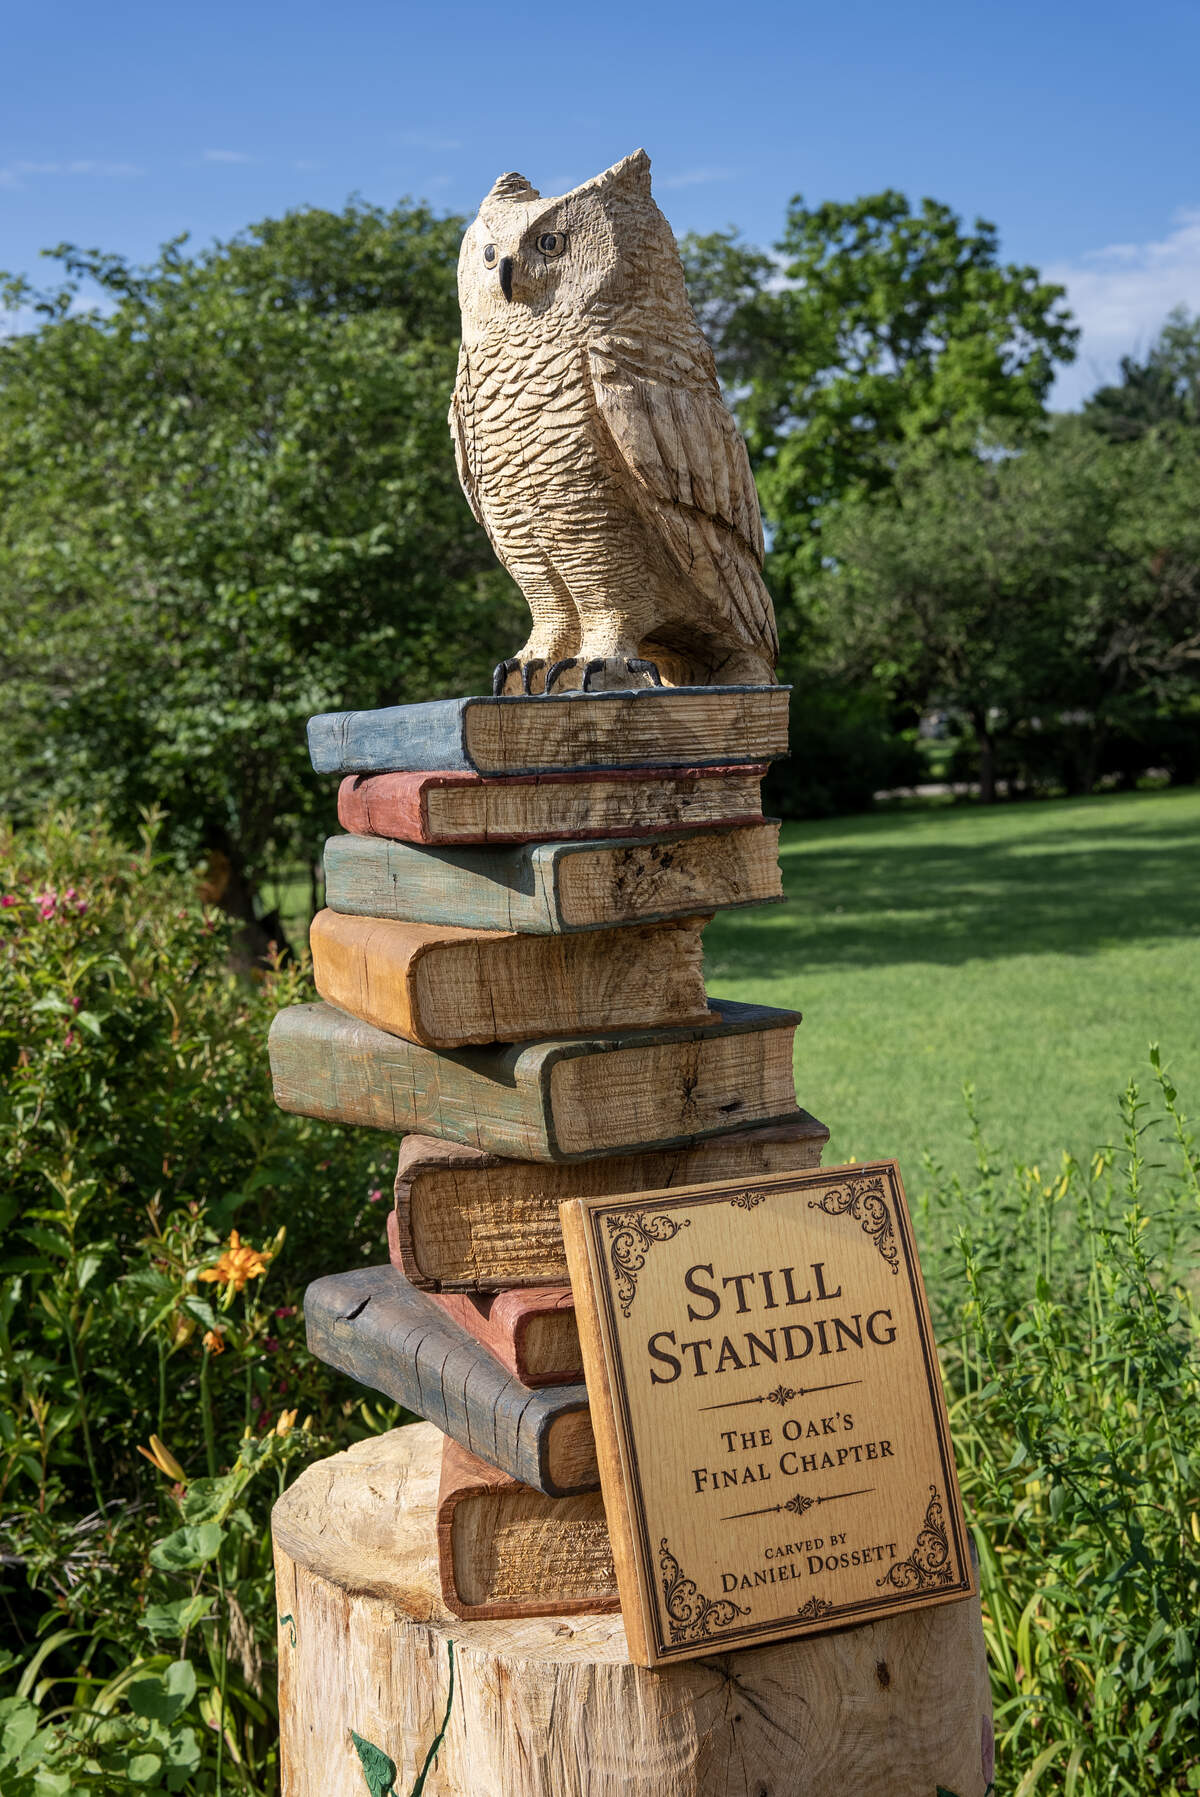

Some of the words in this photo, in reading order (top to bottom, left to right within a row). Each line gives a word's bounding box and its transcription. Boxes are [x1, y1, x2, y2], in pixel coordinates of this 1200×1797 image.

[684, 1263, 842, 1322] STILL
[647, 1309, 897, 1385] STANDING
[692, 1464, 771, 1493] FINAL
[780, 1440, 895, 1475] CHAPTER
[721, 1429, 773, 1453] THE
[721, 1564, 801, 1593] DANIEL
[807, 1543, 897, 1575] DOSSETT
[765, 1538, 824, 1559] CARVED
[830, 1533, 847, 1547] BY
